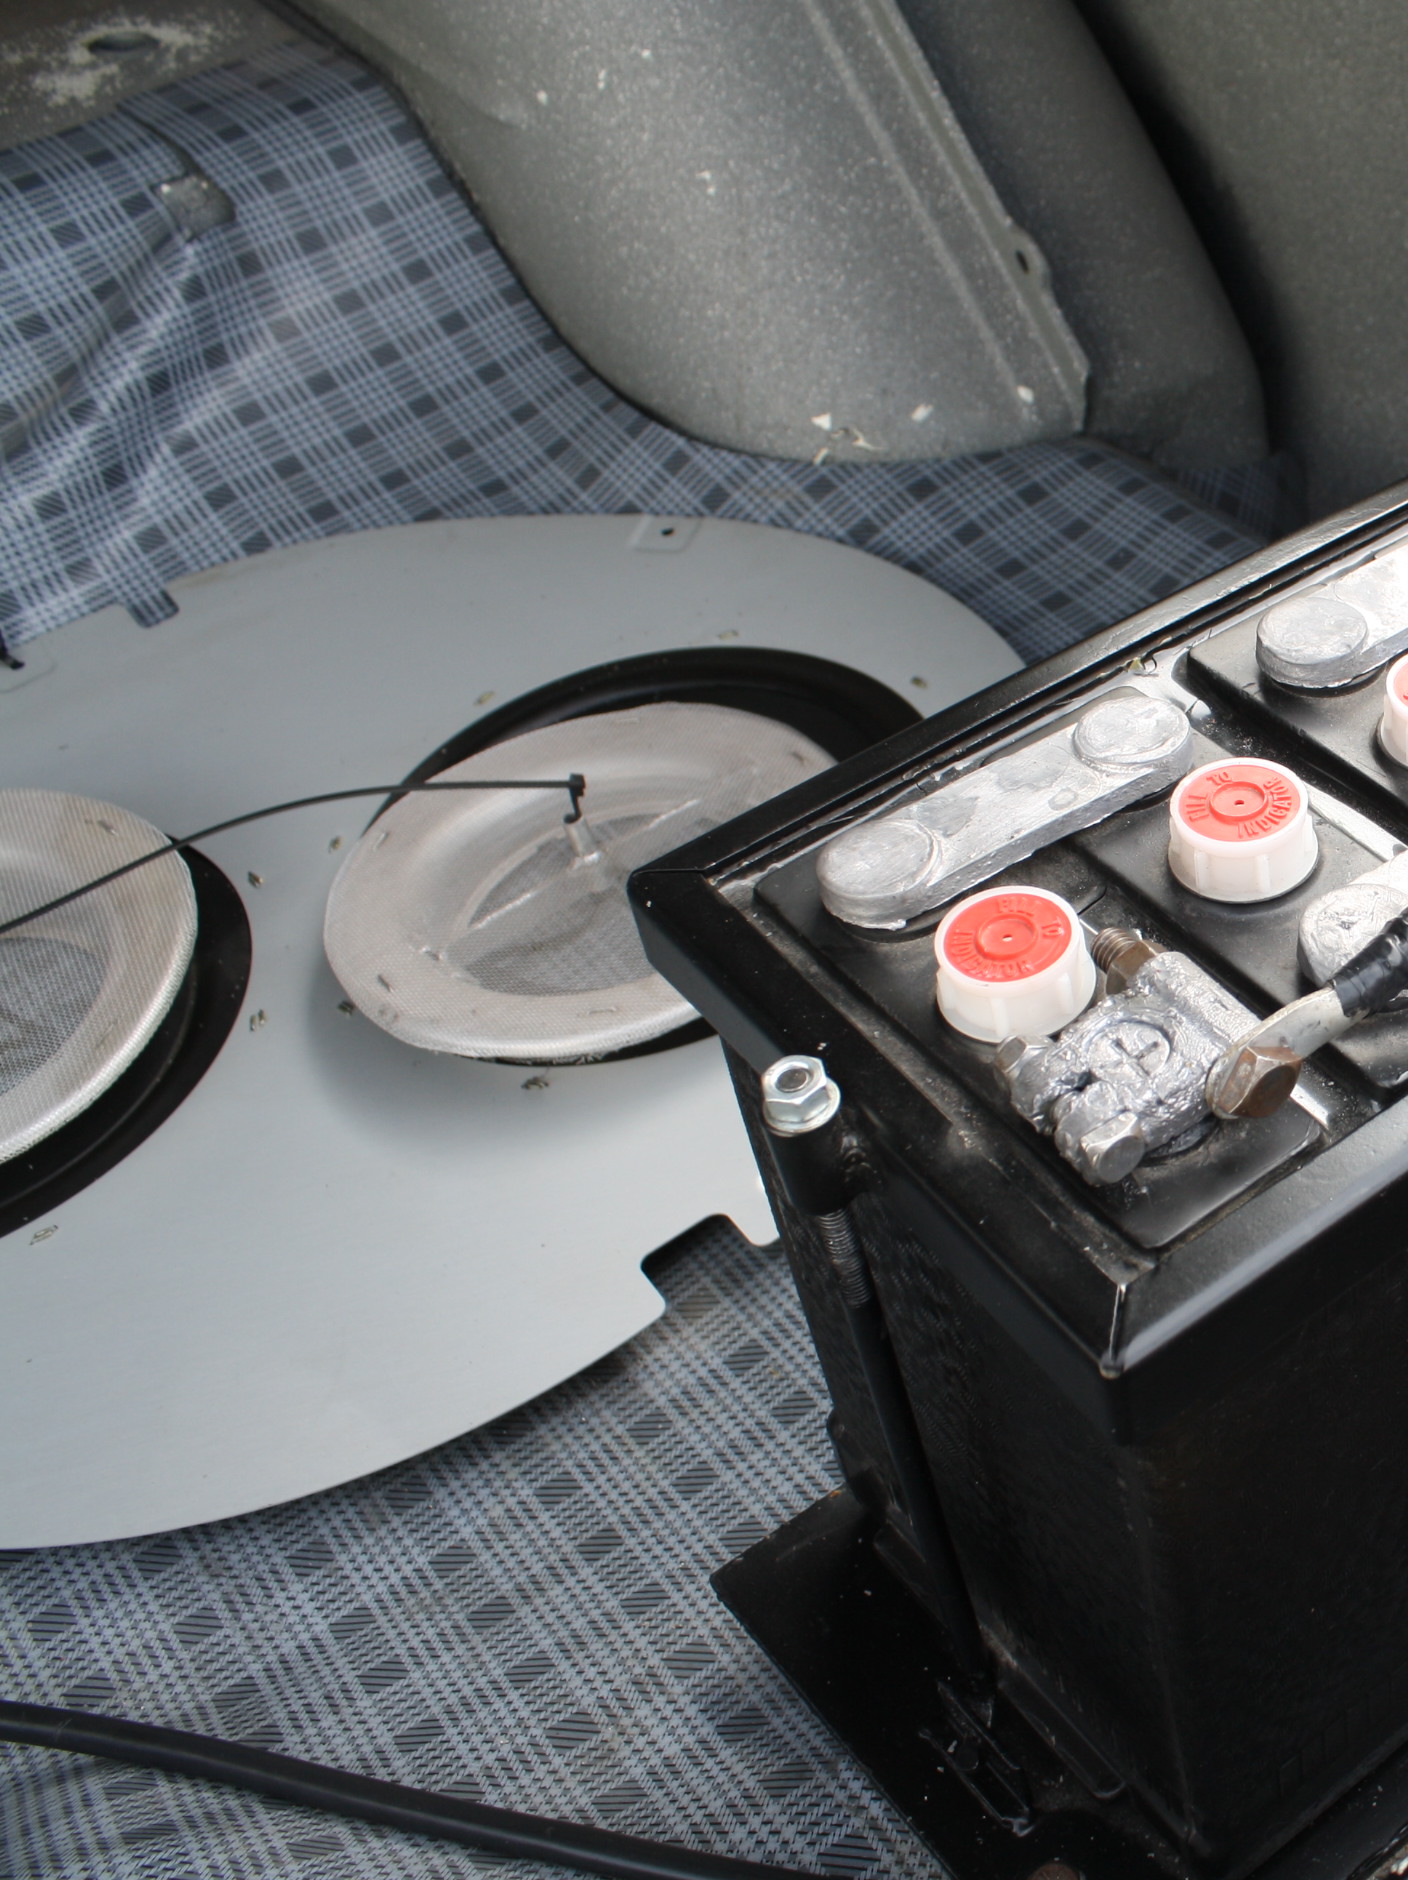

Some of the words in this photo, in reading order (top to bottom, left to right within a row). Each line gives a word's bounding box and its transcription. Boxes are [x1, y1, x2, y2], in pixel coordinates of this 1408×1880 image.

[1186, 794, 1210, 823] FILL
[1206, 771, 1234, 787] TO
[1237, 777, 1292, 839] INDICATOR
